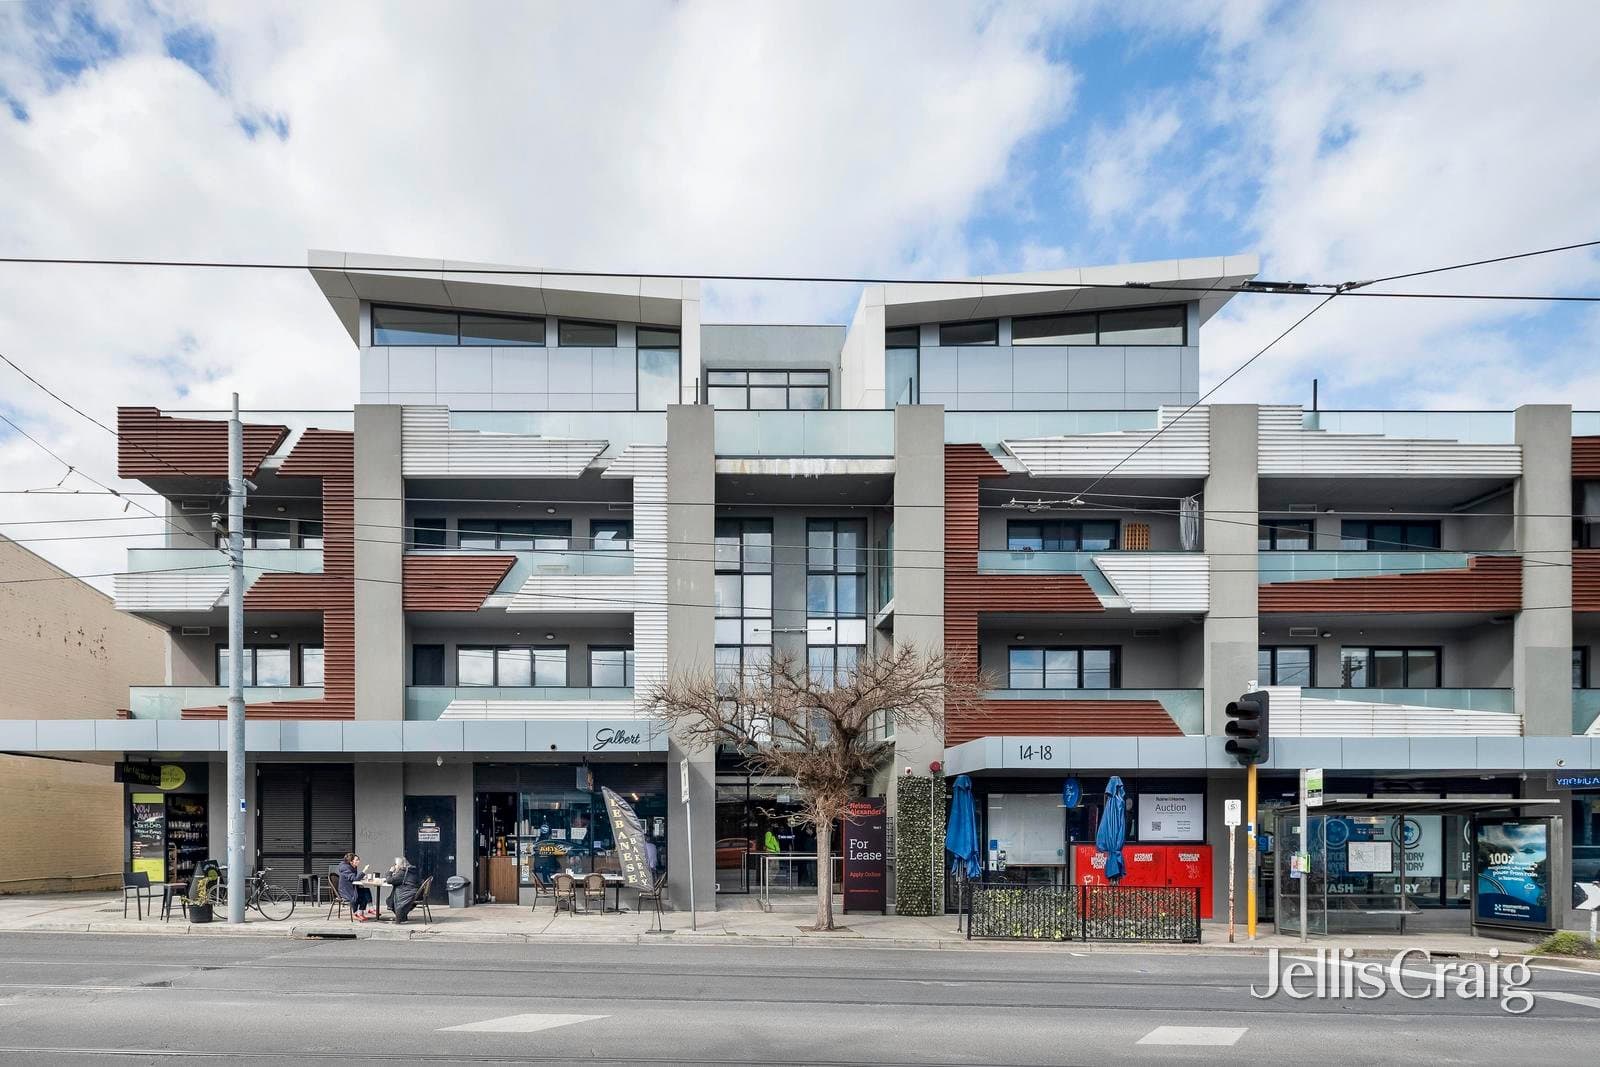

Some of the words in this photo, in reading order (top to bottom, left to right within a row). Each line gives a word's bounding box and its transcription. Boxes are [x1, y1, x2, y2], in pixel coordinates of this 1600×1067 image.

[592, 727, 641, 751] Gilbert
[1019, 744, 1053, 761] 14-18
[1155, 803, 1188, 812] Auction
[608, 798, 638, 884] LEBANESE
[849, 838, 869, 849] For
[629, 837, 648, 886] BAKERY
[849, 849, 882, 861] Lease
[1393, 884, 1420, 894] DRY
